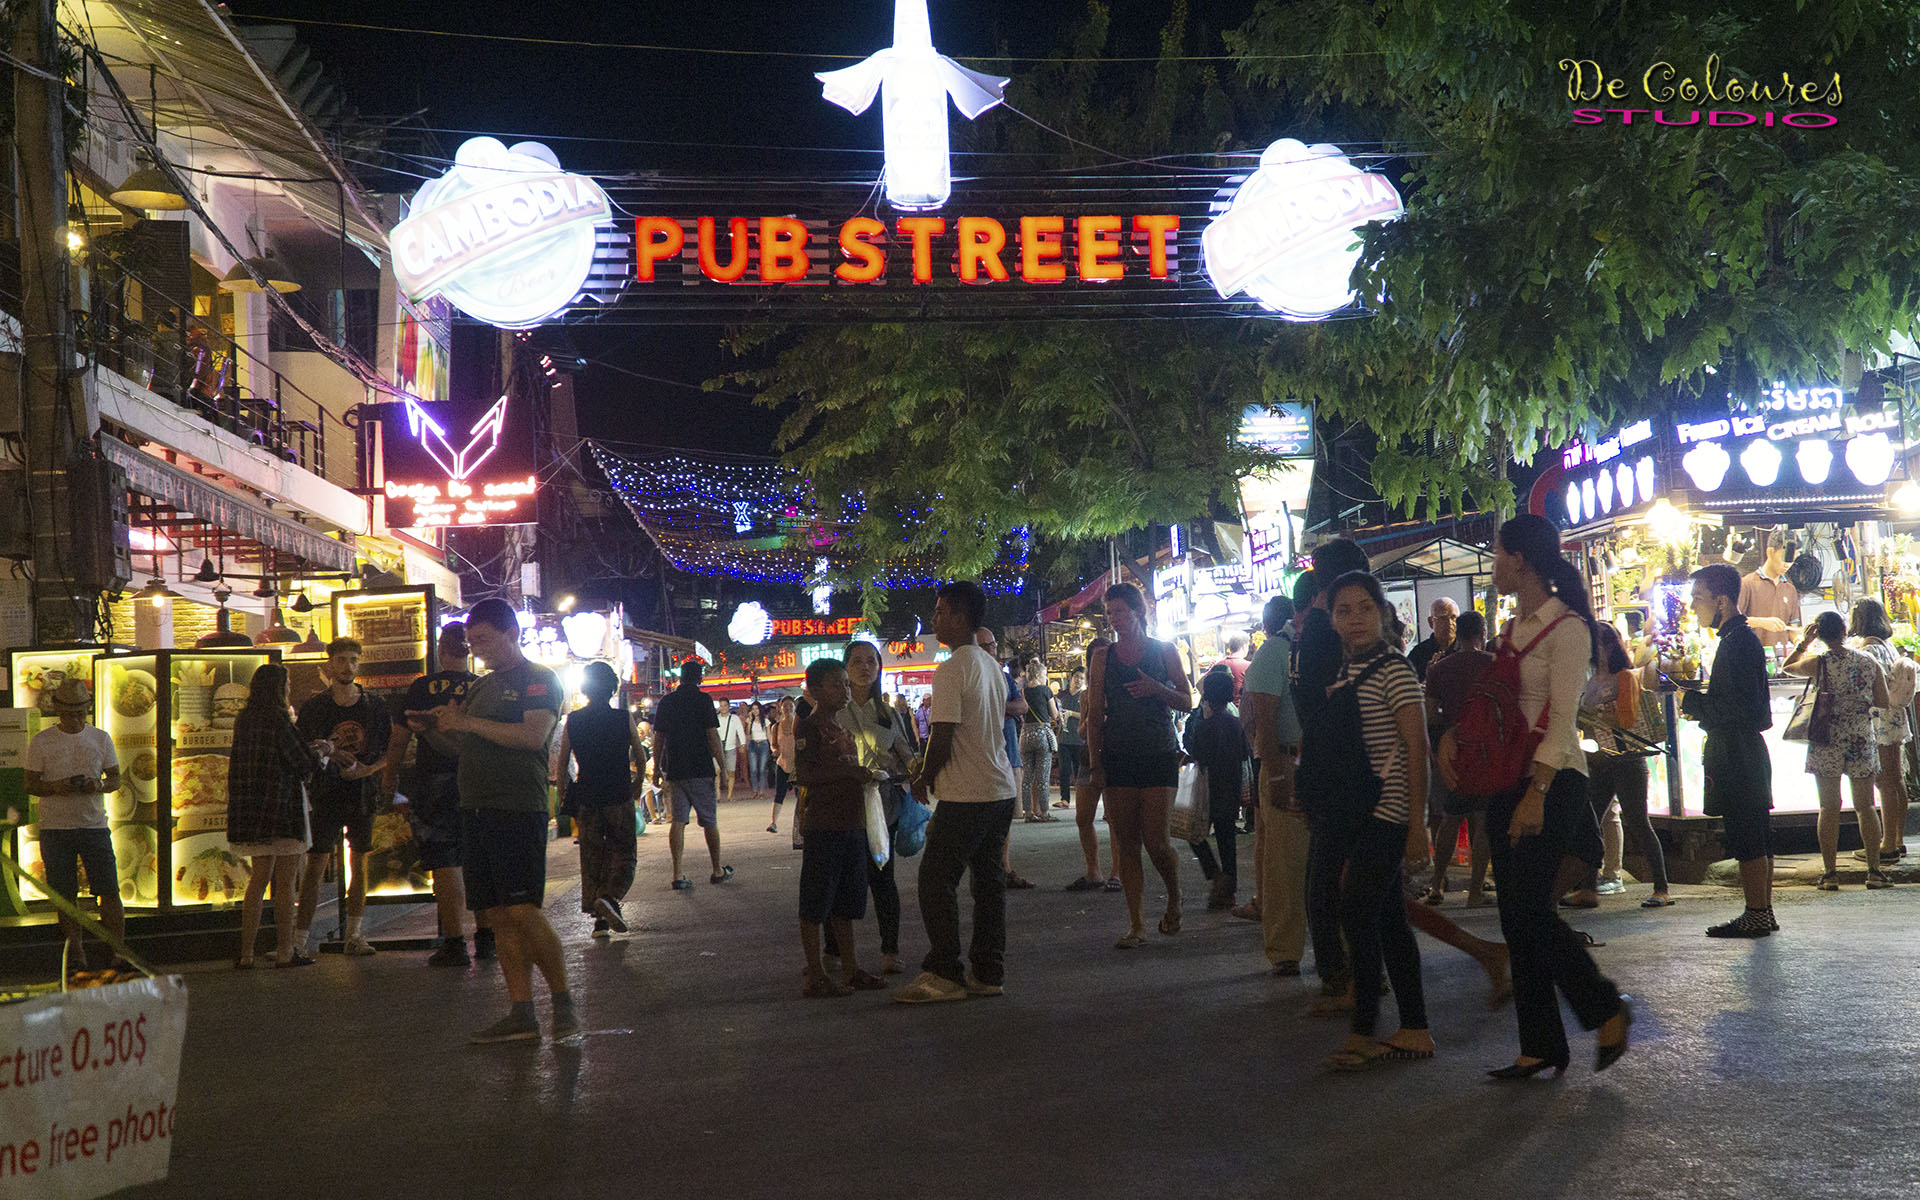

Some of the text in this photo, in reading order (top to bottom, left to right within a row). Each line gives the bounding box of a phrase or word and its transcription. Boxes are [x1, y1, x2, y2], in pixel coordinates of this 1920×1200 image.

[399, 176, 605, 277] CAMBODIA
[635, 215, 1180, 283] PUB STREET
[1211, 175, 1398, 274] CAMBODIA
[1676, 419, 1730, 444] FRIED
[1731, 415, 1766, 437] ICE
[1766, 412, 1842, 441] CREAM
[772, 620, 803, 635] PUB
[182, 735, 216, 745] BURGER
[72, 1012, 147, 1072] 0.50$
[50, 1121, 99, 1168] free
